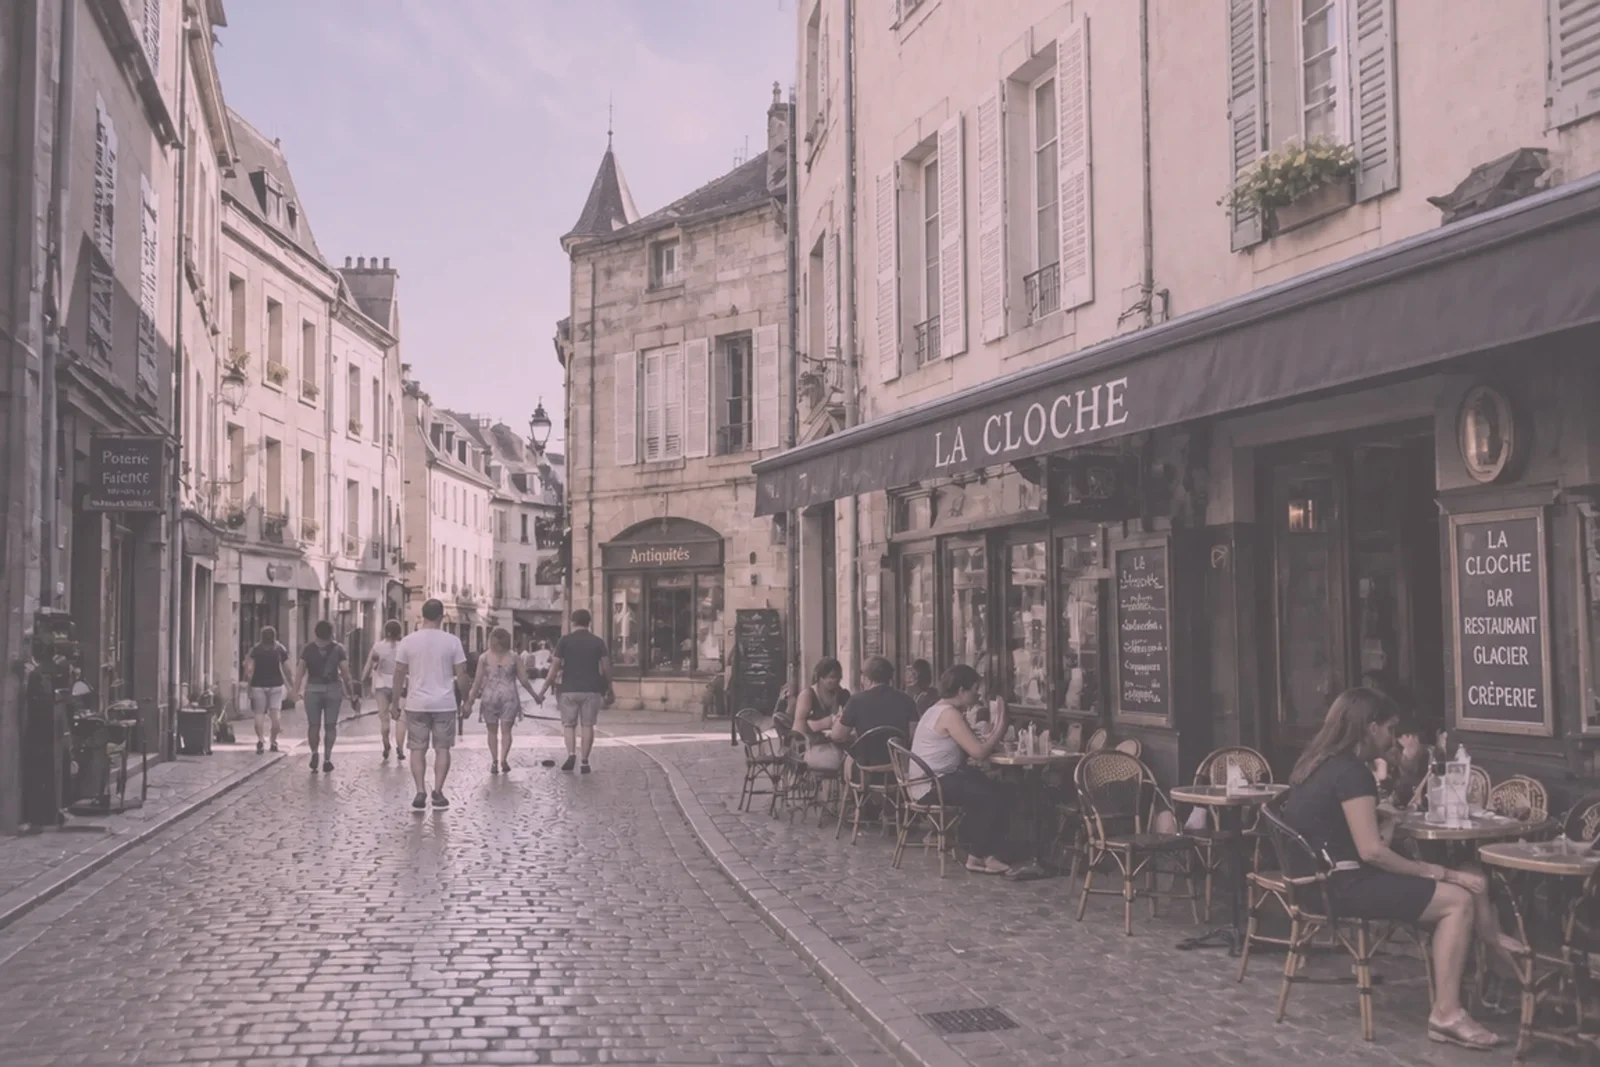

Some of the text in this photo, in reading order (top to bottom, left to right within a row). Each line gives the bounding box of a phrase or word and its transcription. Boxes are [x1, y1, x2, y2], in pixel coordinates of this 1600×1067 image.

[935, 376, 1129, 467] LA CLOCHE
[1487, 530, 1508, 549] LA
[630, 546, 690, 566] Antiquités
[1466, 552, 1532, 576] CLOCHE
[1487, 588, 1514, 607] BAR
[1465, 617, 1538, 635] RESTAURANT
[1474, 646, 1529, 666] GLACIER
